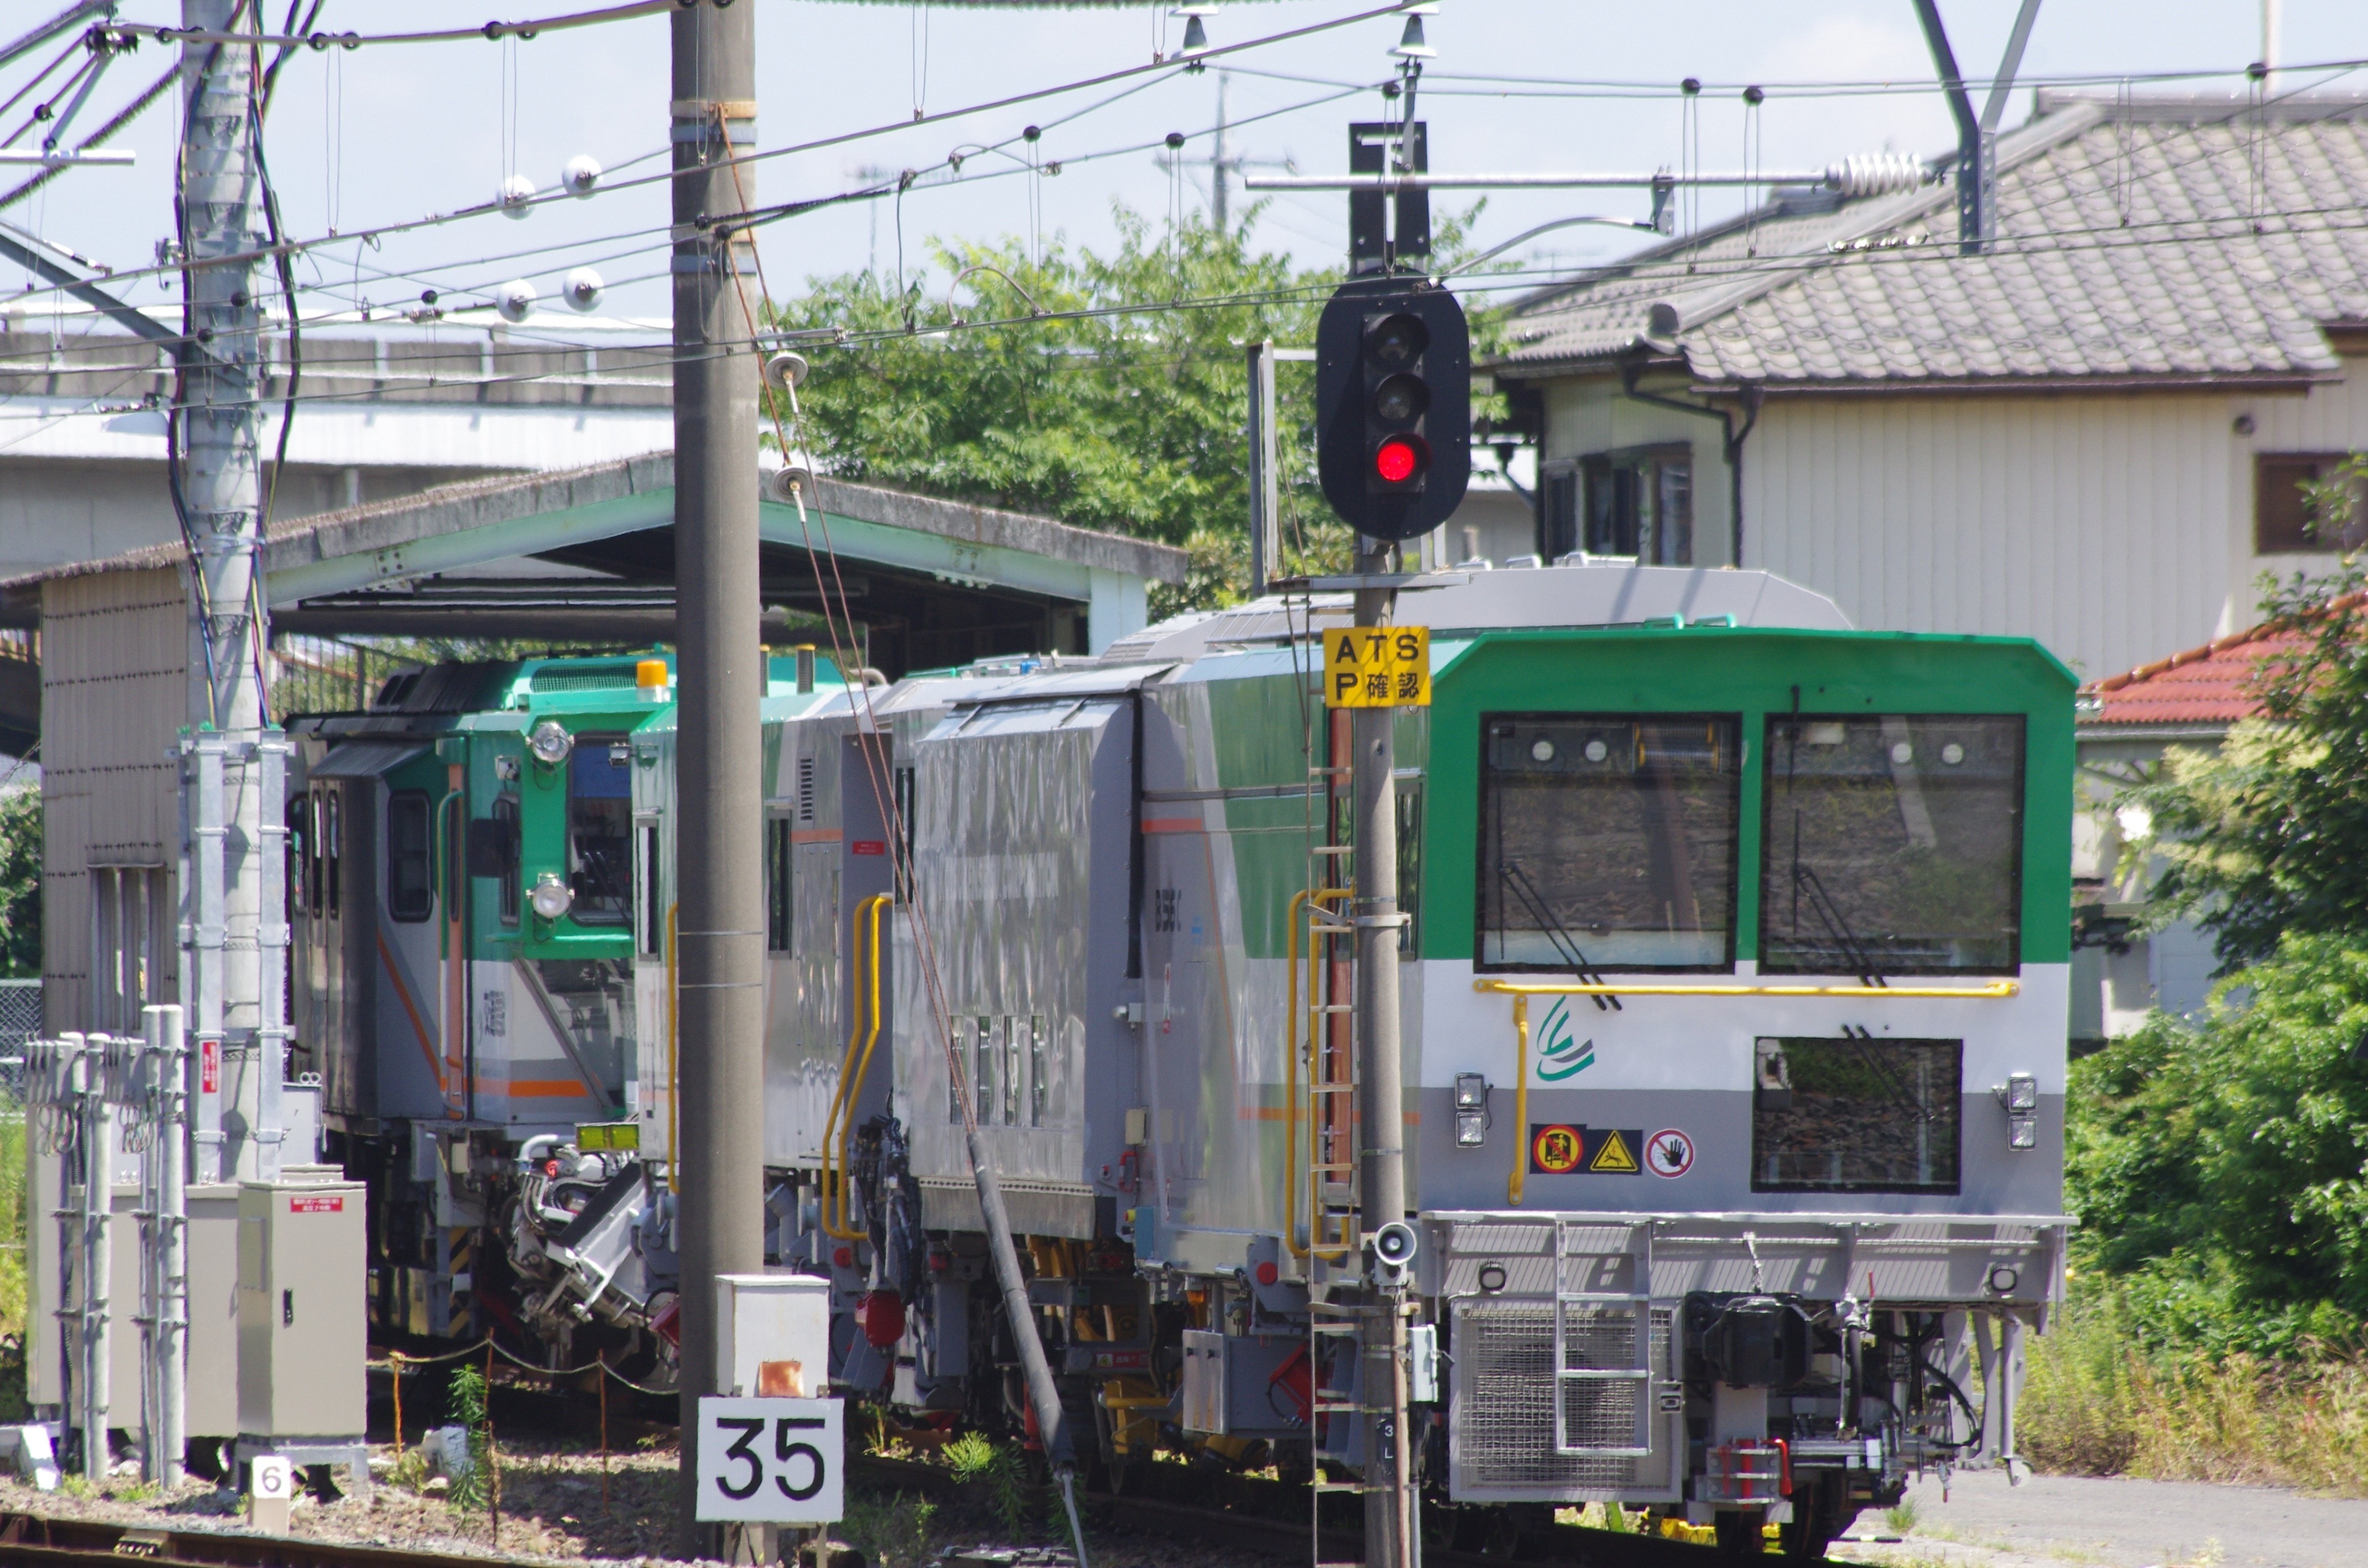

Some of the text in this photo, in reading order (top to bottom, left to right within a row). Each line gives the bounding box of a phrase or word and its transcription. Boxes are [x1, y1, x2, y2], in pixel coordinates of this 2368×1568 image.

[1335, 634, 1419, 663] ATS
[716, 1417, 825, 1501] 35
[262, 1466, 282, 1493] 6
